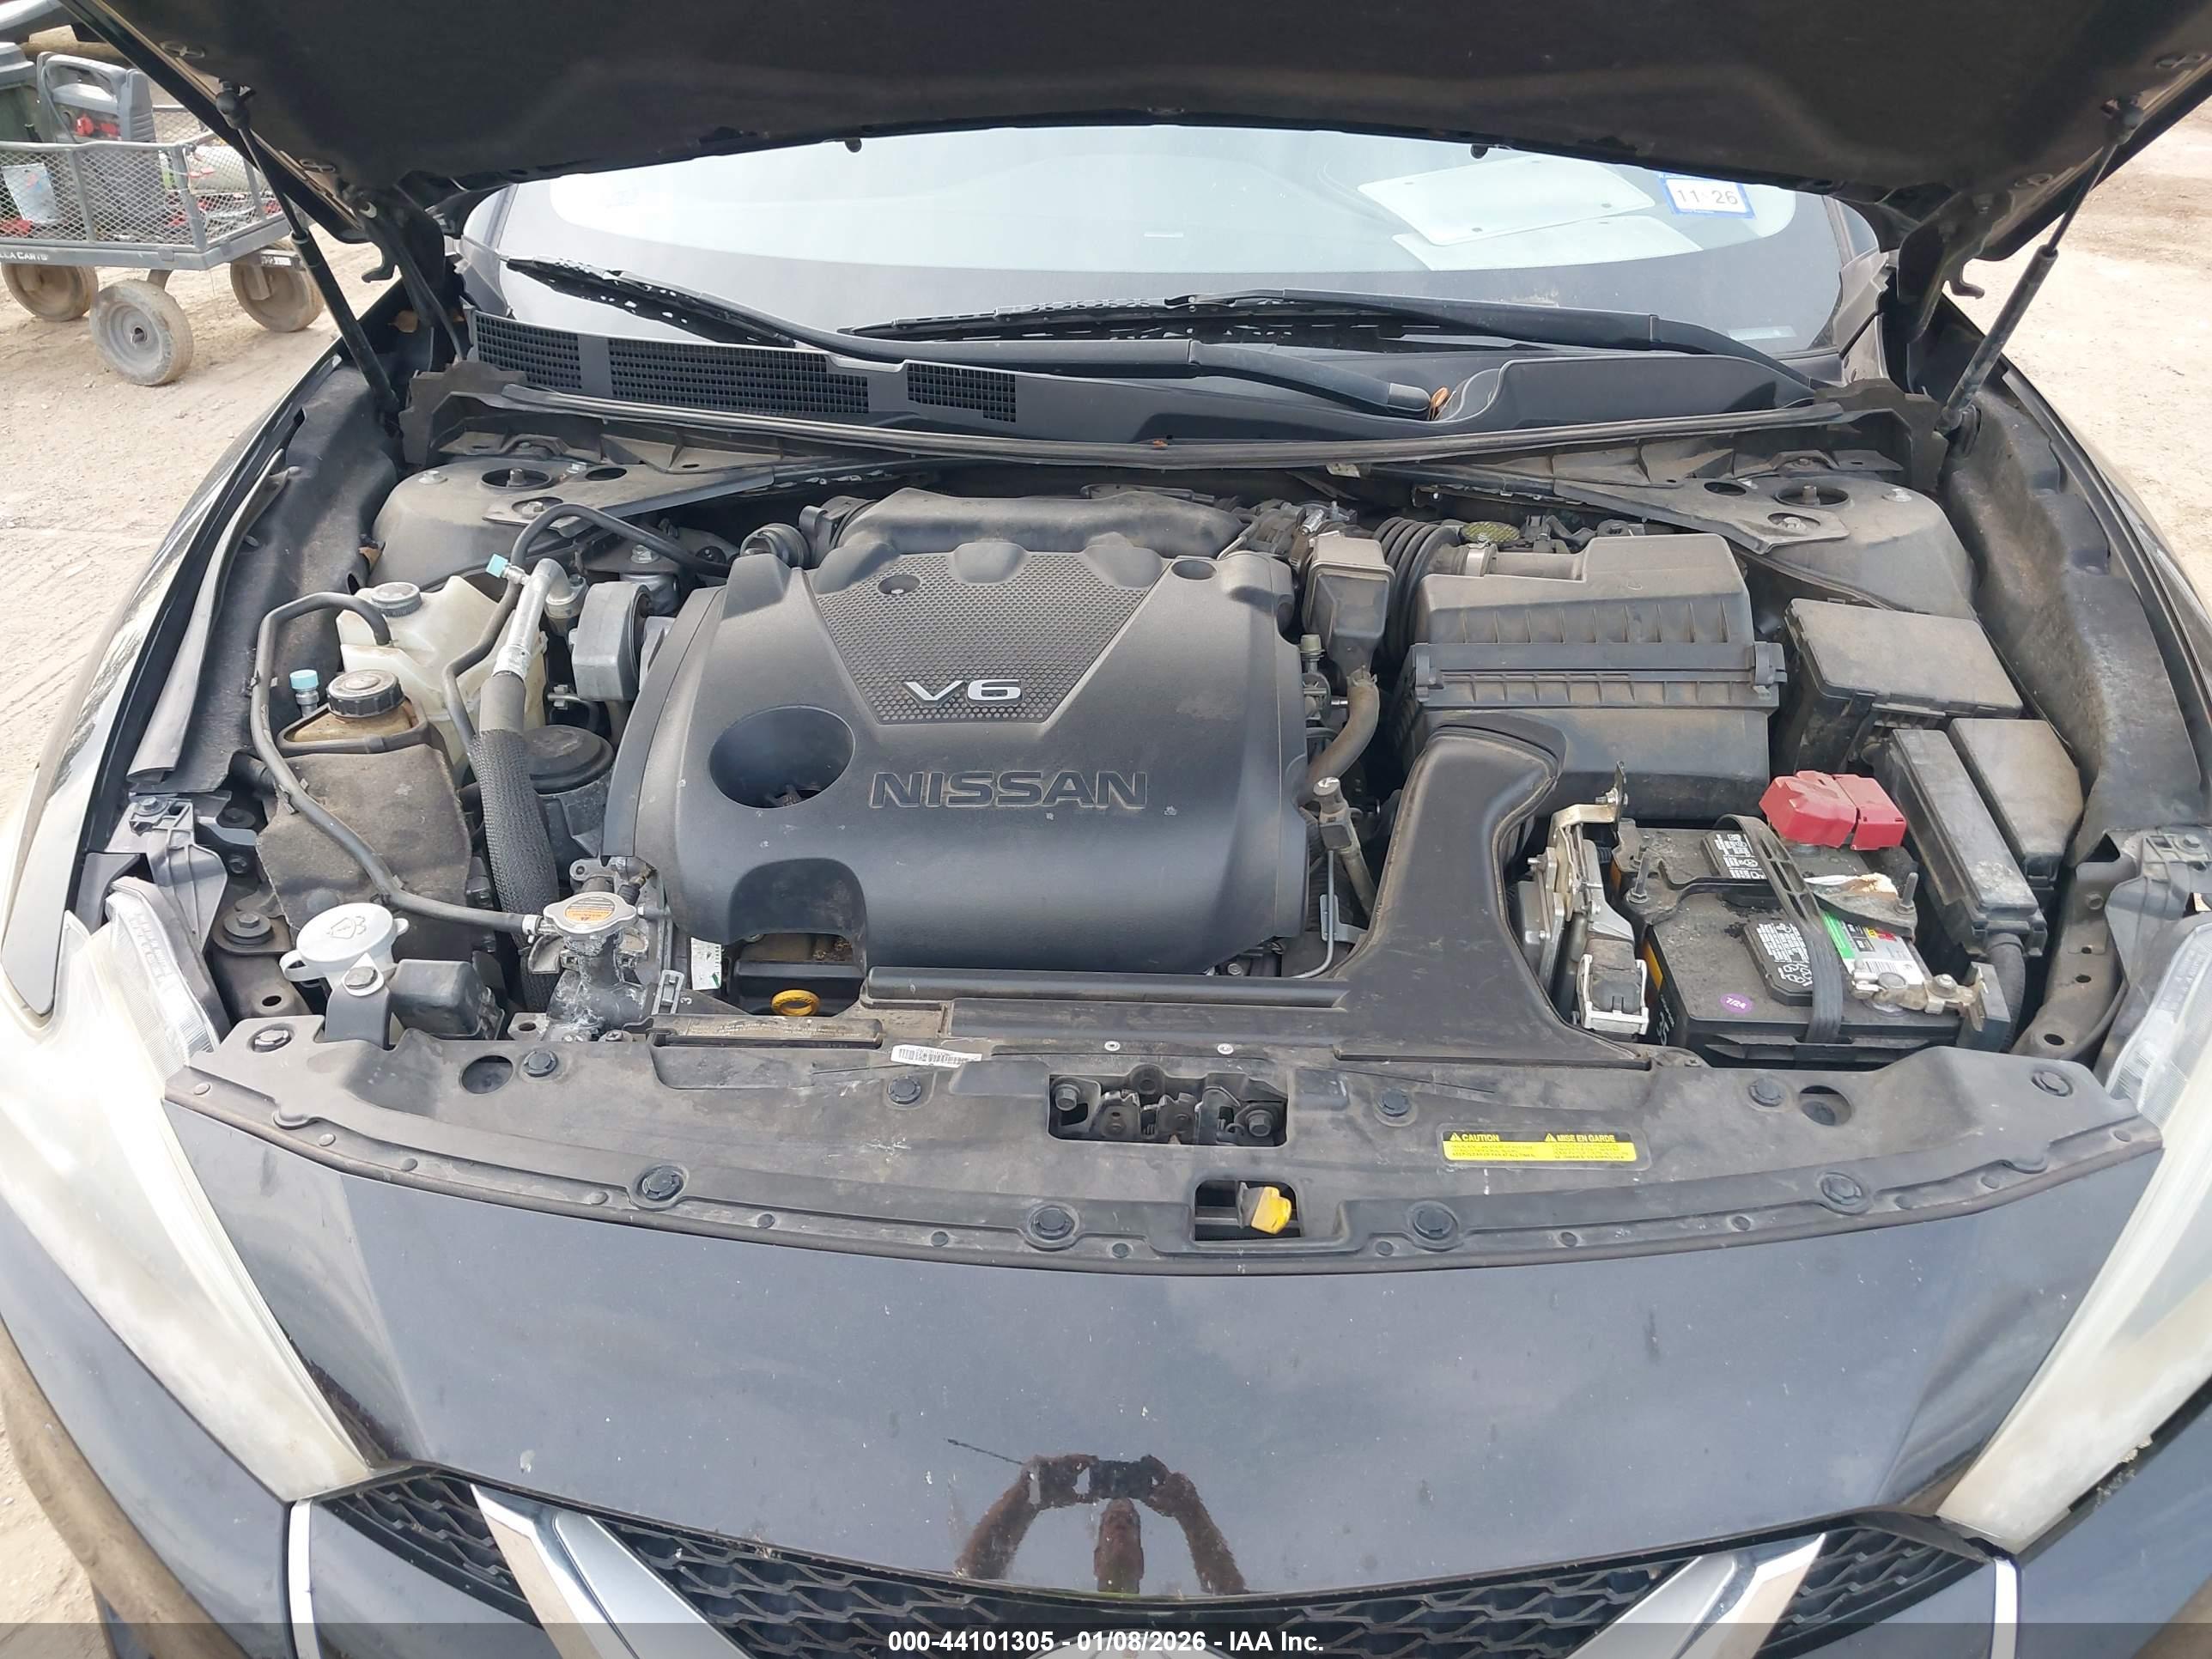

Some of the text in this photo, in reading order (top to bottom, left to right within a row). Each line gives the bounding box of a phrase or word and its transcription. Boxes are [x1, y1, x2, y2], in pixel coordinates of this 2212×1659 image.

[1677, 190, 1738, 205] 11 26
[905, 679, 1022, 702] V6
[869, 771, 1148, 809] NISSAN
[1462, 1133, 1500, 1142] CAUTION
[1589, 1134, 1616, 1143] GARDE
